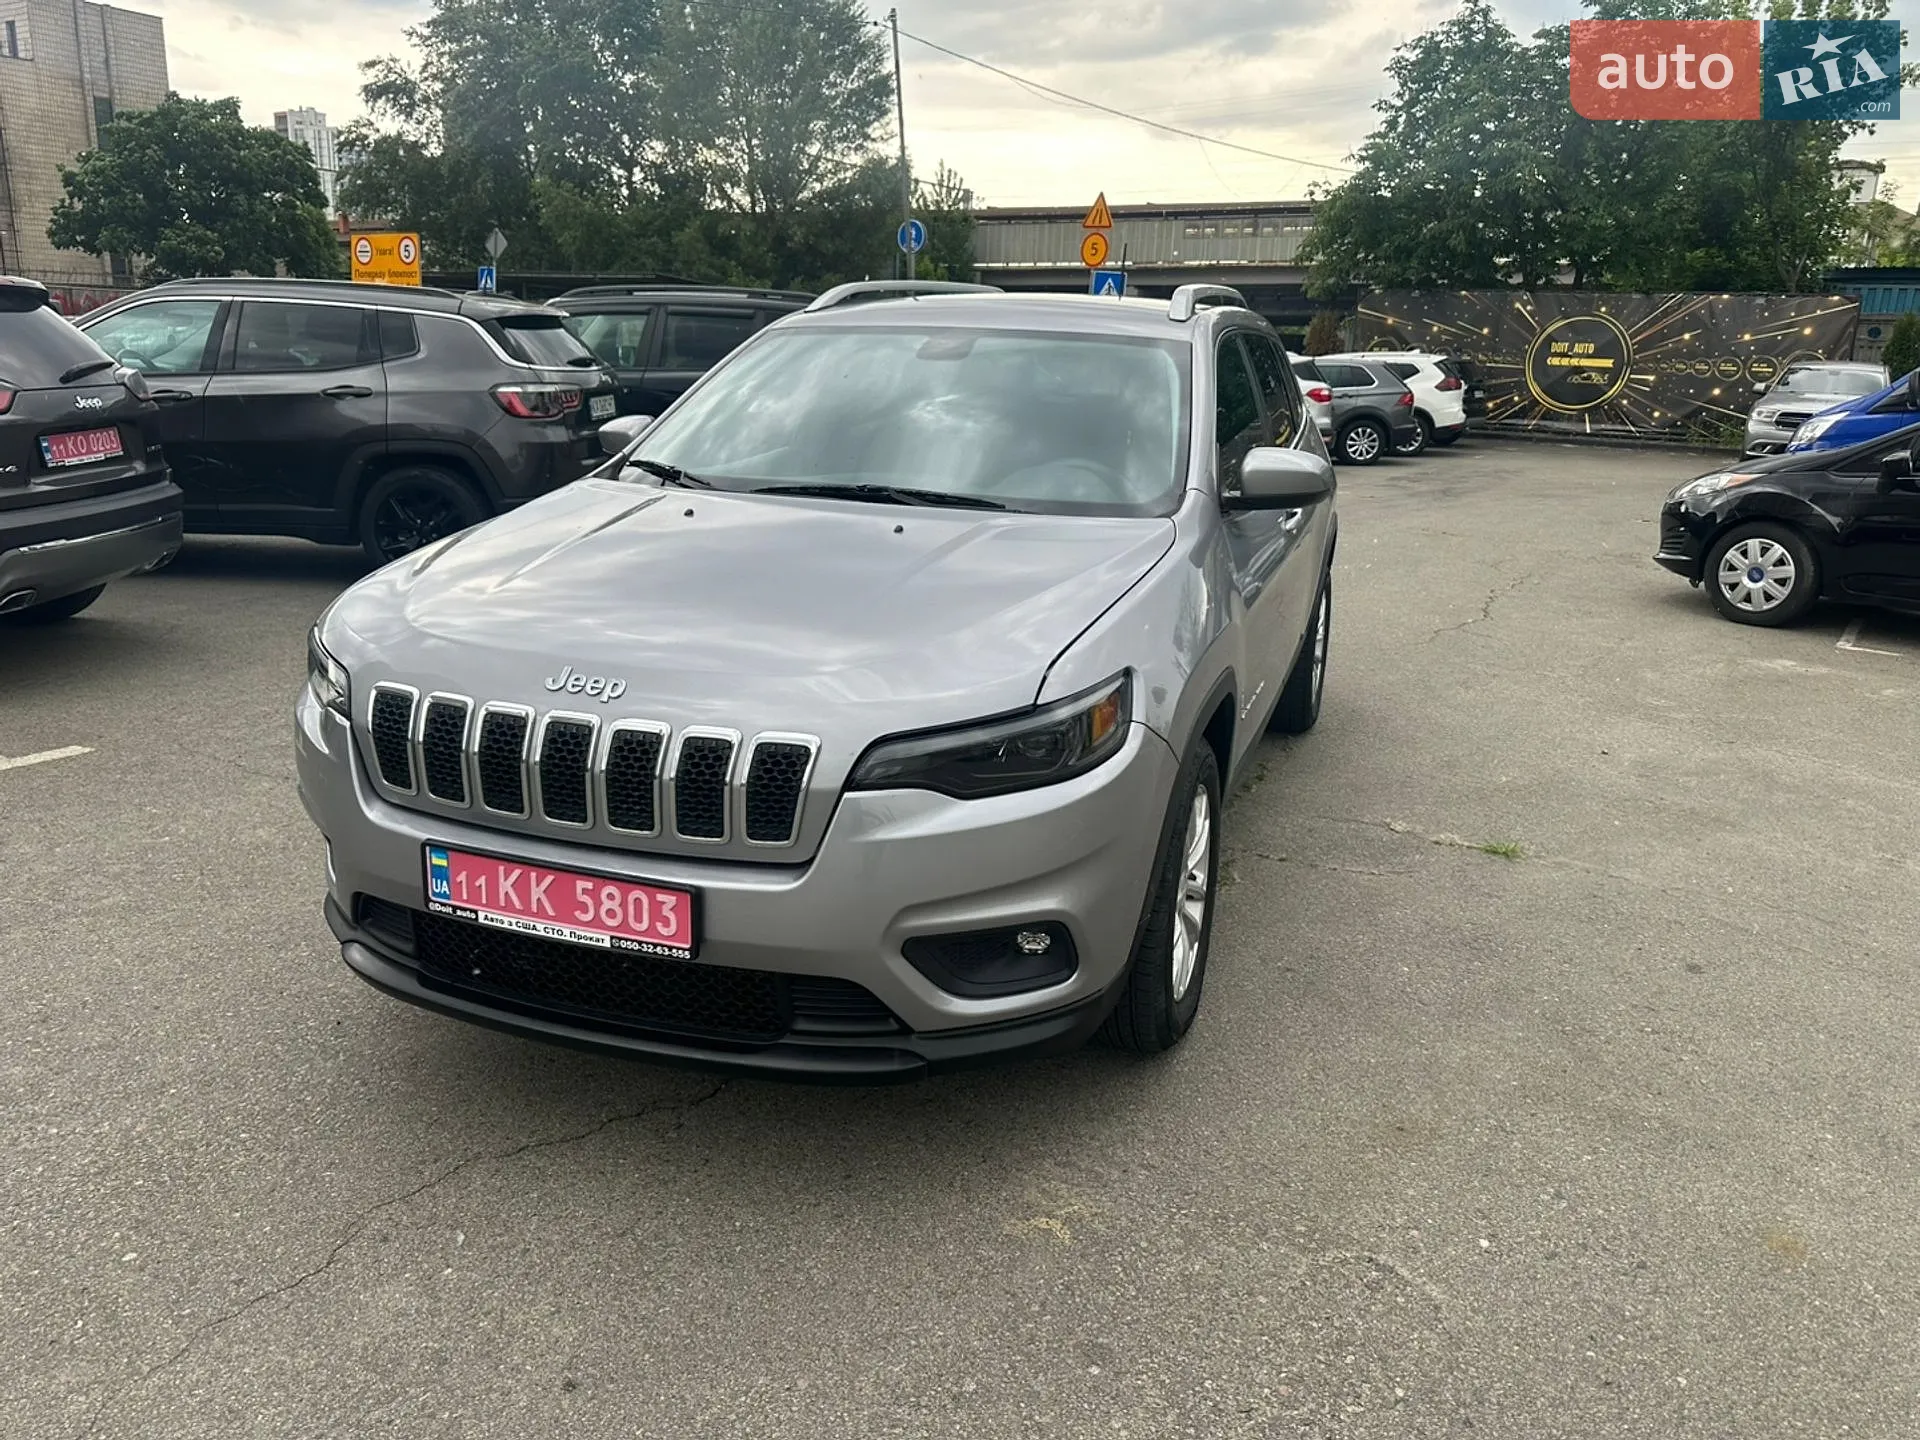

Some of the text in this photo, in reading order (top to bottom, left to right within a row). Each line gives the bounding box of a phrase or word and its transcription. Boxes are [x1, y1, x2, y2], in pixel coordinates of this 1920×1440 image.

[403, 244, 411, 259] 5
[1090, 242, 1099, 257] 5
[74, 395, 103, 410] Jeep
[89, 430, 117, 452] 0203
[544, 665, 627, 704] Jeep
[431, 877, 450, 895] UA
[573, 879, 678, 937] 5803
[569, 930, 606, 944] Прокат
